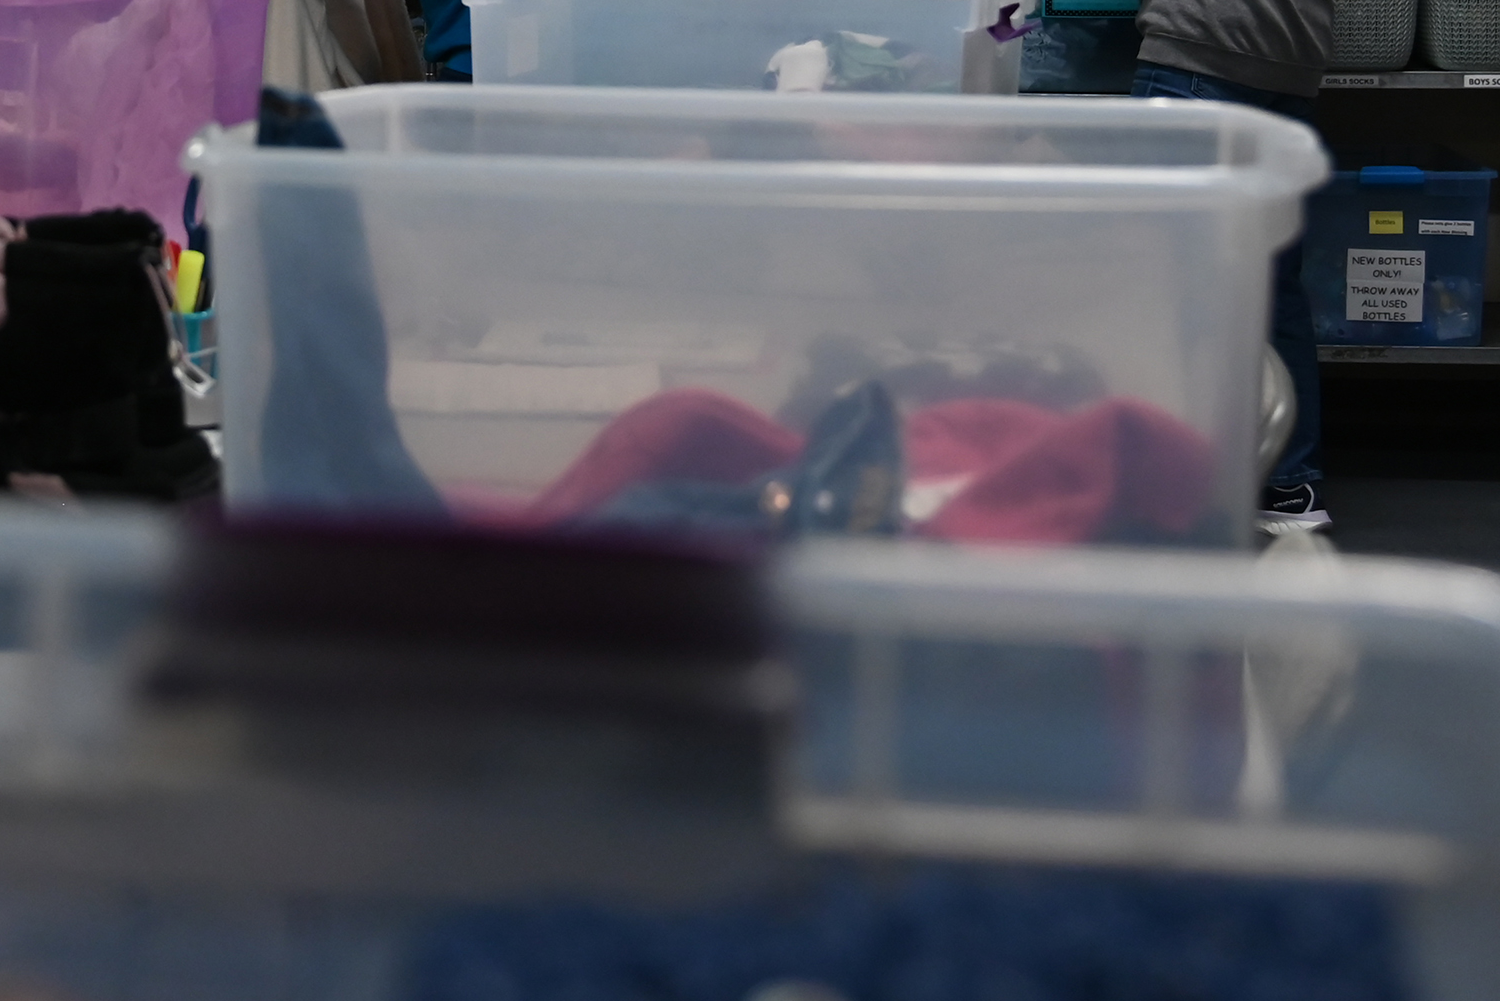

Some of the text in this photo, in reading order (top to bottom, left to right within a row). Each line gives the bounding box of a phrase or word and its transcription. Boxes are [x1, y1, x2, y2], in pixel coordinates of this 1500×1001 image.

[1468, 78, 1490, 86] BOYS
[1352, 256, 1422, 266] NEW BOTTLES
[1372, 269, 1402, 278] ONLY!
[1351, 286, 1420, 296] THROW AWAY
[1361, 299, 1408, 309] ALL USED
[1362, 311, 1406, 321] BOTTLES
